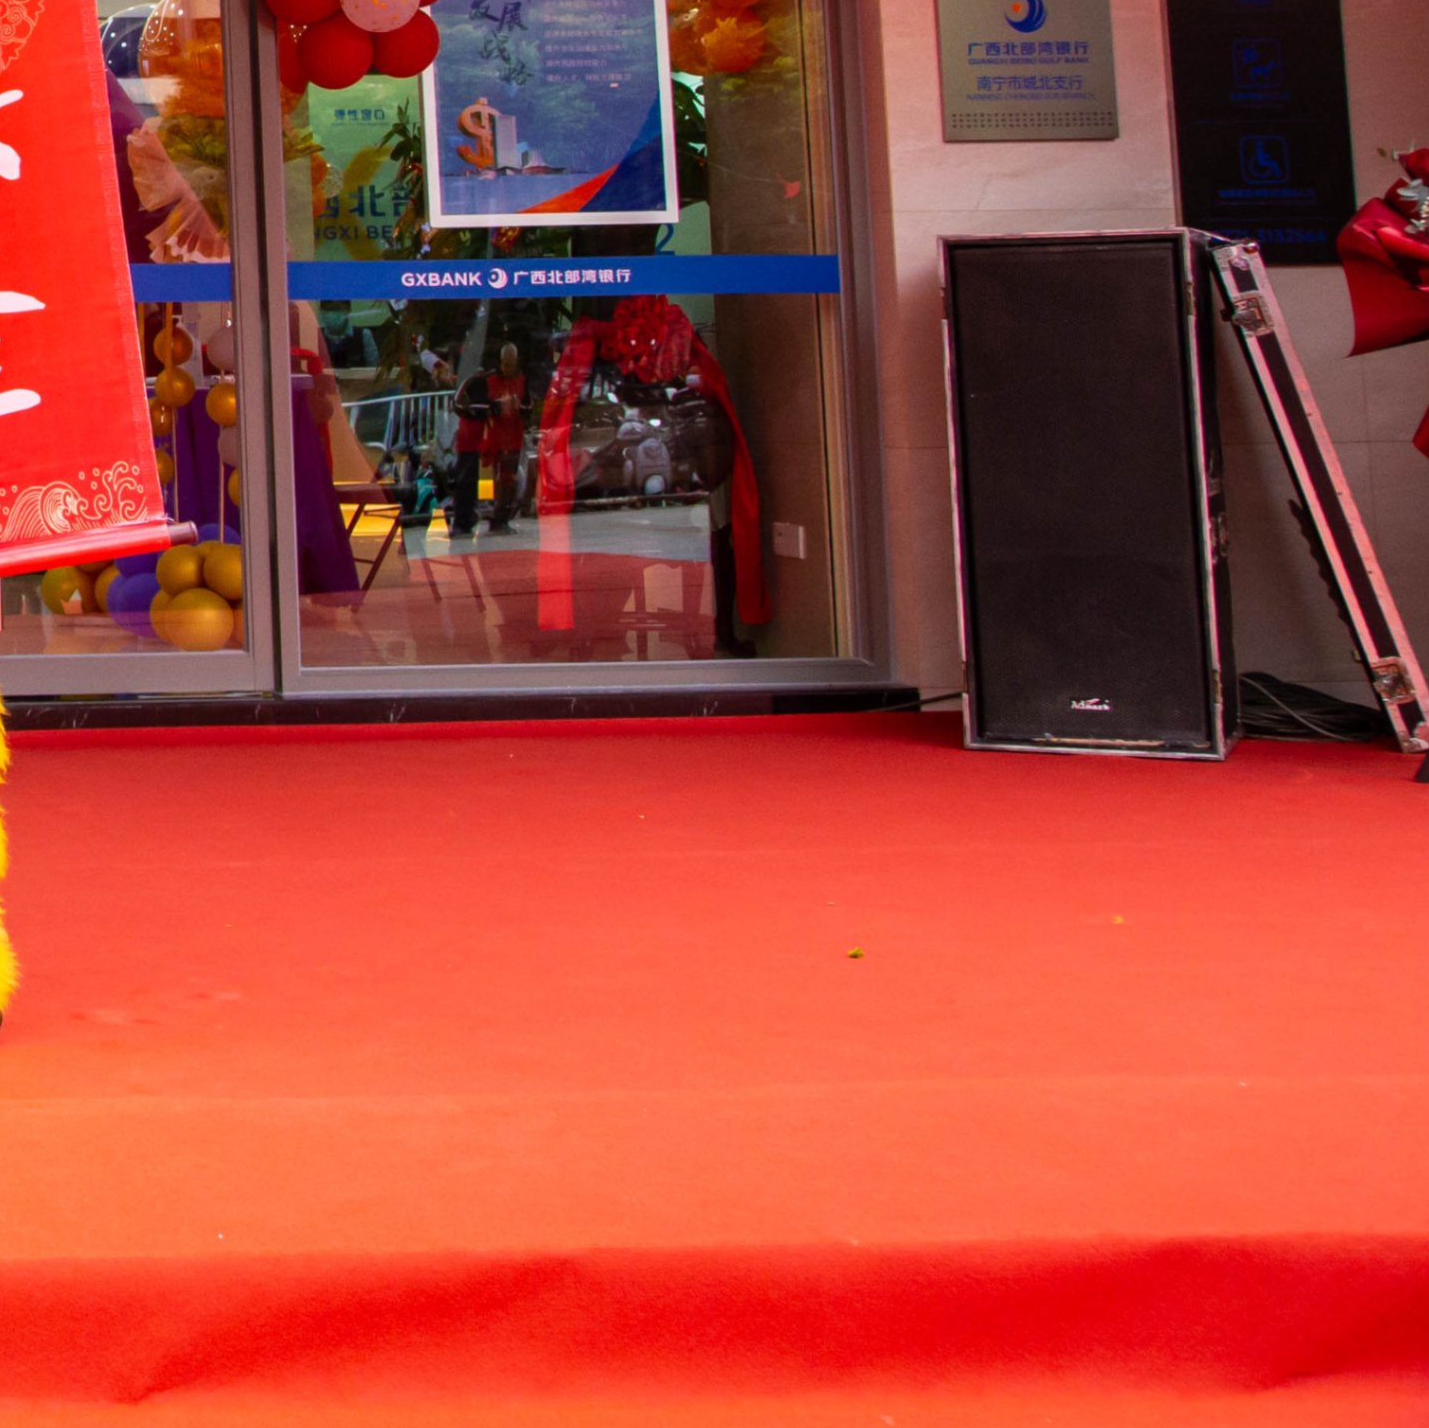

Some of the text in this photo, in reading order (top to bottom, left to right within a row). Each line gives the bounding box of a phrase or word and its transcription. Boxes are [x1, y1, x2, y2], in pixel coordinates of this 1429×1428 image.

[967, 41, 1089, 56] 广西北部湾银行
[977, 75, 1083, 91] 南宁市城北支行
[315, 224, 359, 240] GXI
[400, 271, 482, 288] GXBANK
[513, 268, 632, 286] 广西北部湾银行
